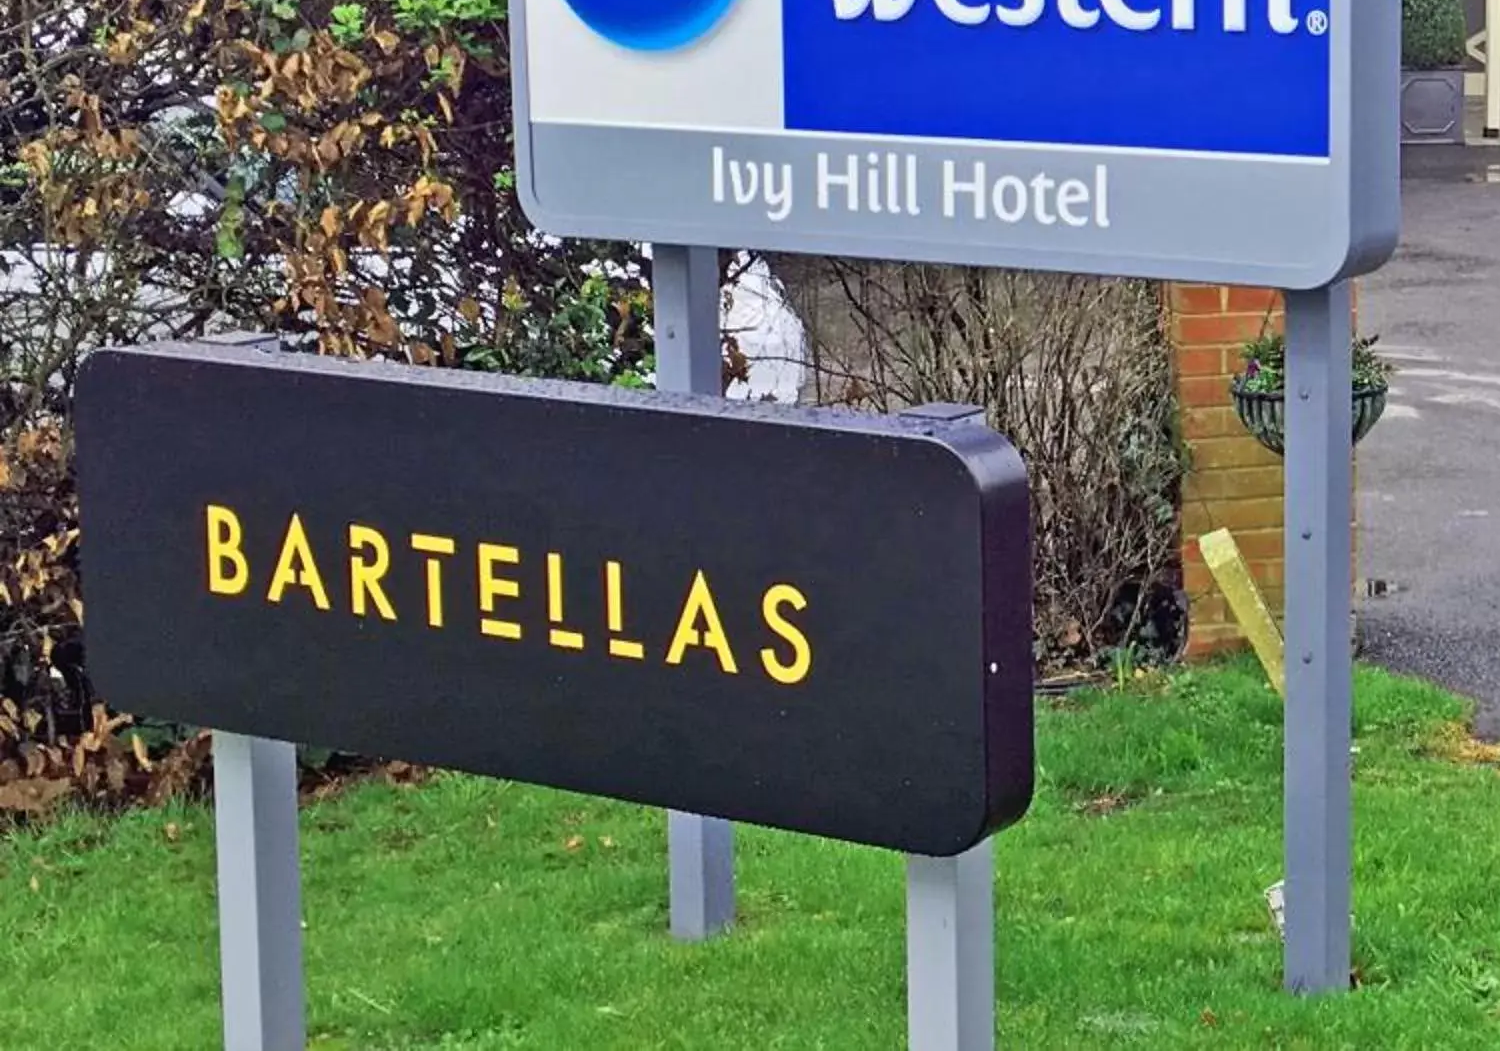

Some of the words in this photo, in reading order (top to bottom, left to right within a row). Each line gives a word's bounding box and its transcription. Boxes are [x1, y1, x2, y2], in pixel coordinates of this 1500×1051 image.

[711, 146, 794, 222] Ivy
[816, 152, 921, 216] Hill
[942, 160, 1110, 228] Hotel
[206, 504, 812, 684] BARTELLAS
